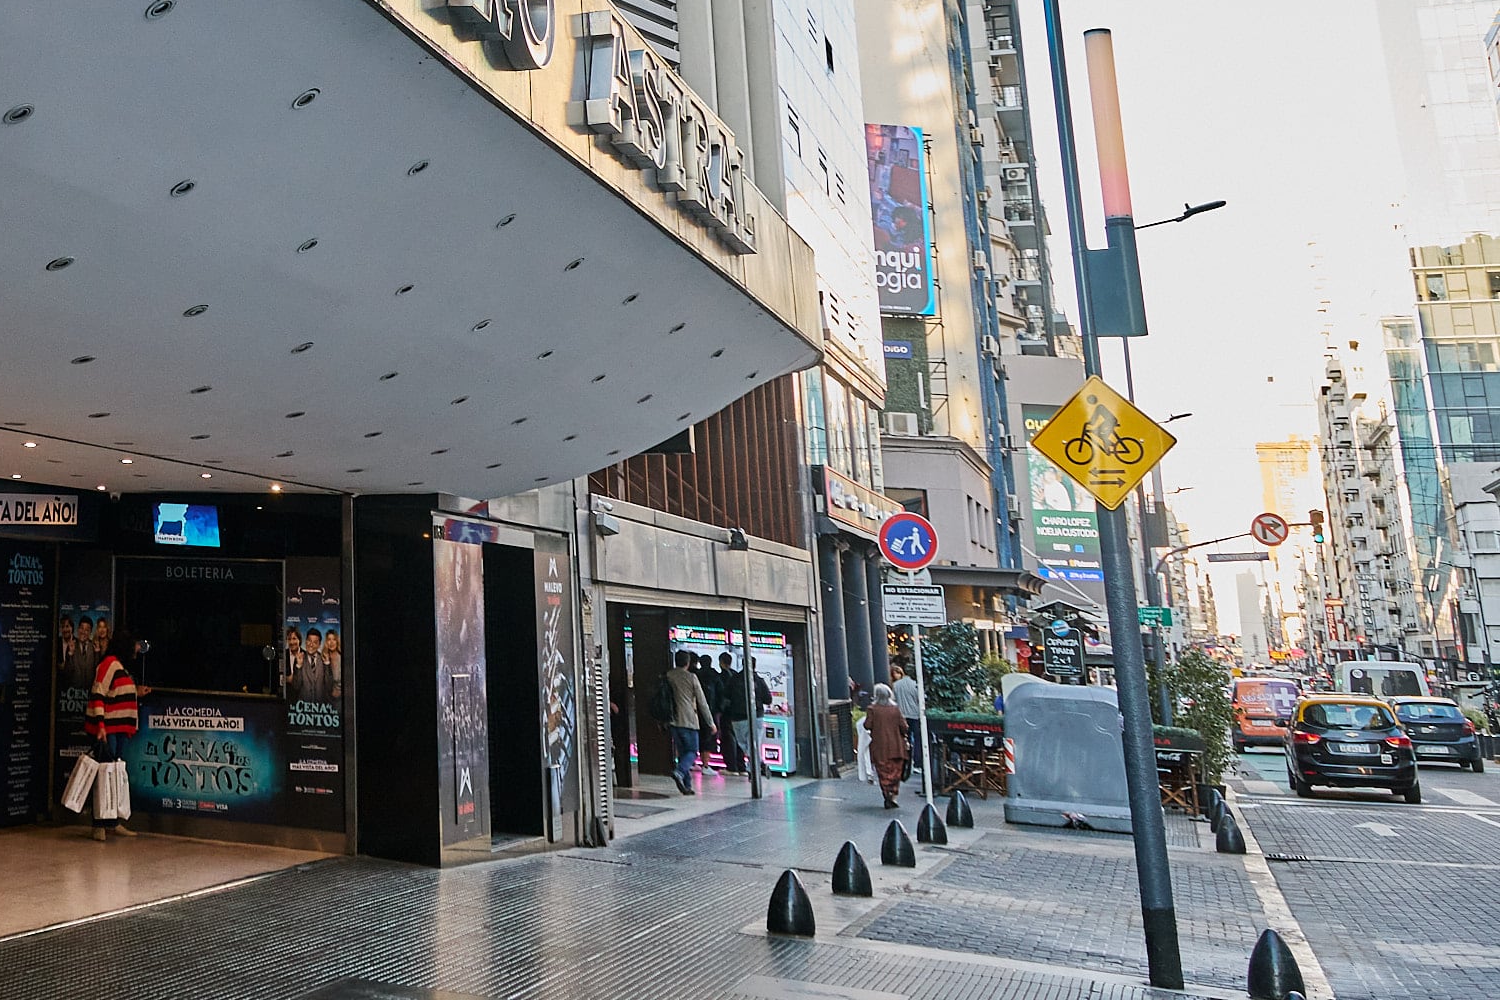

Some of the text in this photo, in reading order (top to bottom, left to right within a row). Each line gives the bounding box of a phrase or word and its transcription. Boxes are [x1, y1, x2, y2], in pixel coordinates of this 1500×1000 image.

[586, 10, 757, 254] ASTRAL
[14, 502, 40, 522] DEL
[42, 497, 76, 523] AÑO!
[14, 552, 38, 568] CENA
[8, 570, 44, 586] TONTOS
[897, 587, 940, 595] ESTACIONAR
[66, 687, 90, 700] CEN
[181, 707, 222, 717] COMEDIA
[296, 699, 327, 714] CENA
[152, 716, 240, 729] MÁS VISTA DEL AÑO!
[288, 713, 340, 728] TONTOS
[158, 733, 227, 763] CENA
[140, 762, 254, 796] TONTOS
